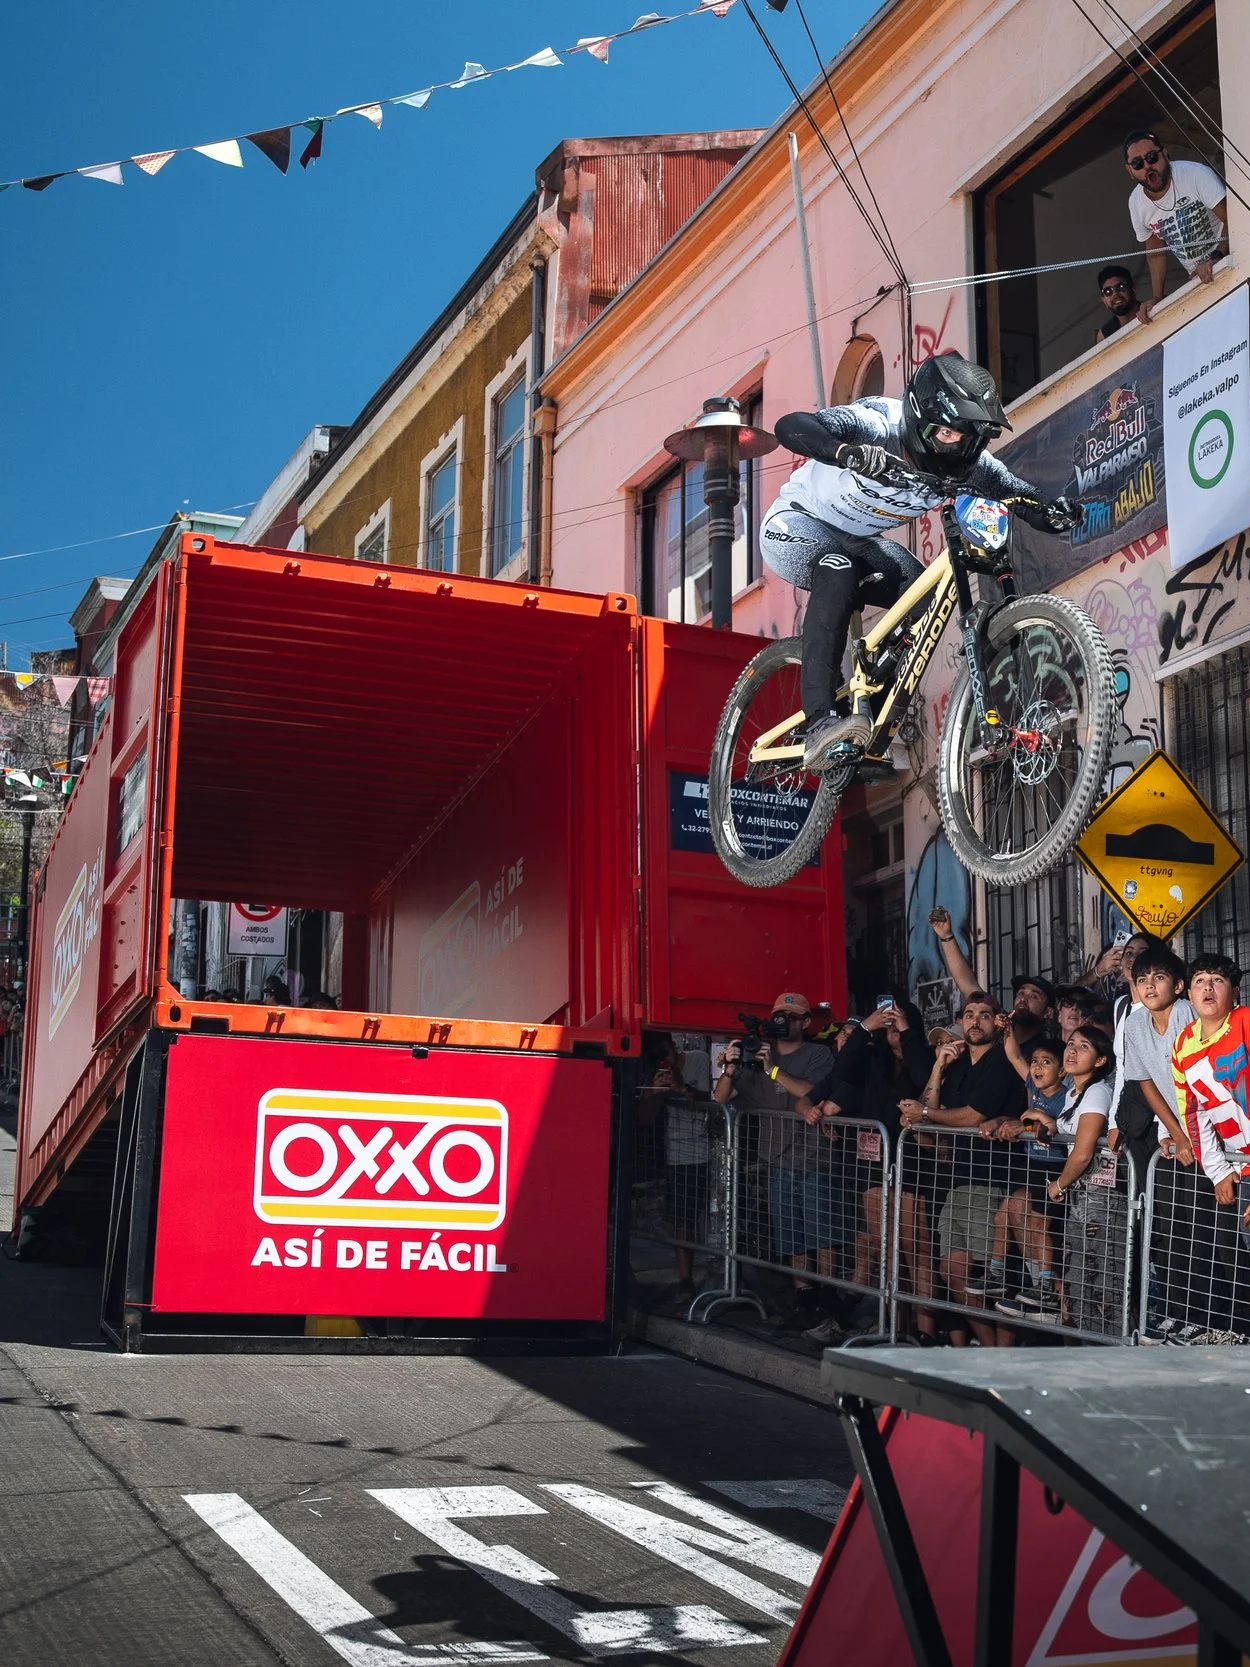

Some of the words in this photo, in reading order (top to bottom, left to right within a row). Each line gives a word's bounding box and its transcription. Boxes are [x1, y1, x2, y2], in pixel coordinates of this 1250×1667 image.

[1176, 200, 1204, 220] Minds
[1200, 365, 1209, 377] En
[1211, 340, 1247, 370] Instagram
[1178, 374, 1239, 419] @lakeka.valpo
[1086, 423, 1115, 465] Red
[1115, 405, 1146, 450] Bull
[1197, 440, 1223, 460] LAKEKA
[1074, 436, 1147, 496] VALPARAISO
[1114, 459, 1154, 527] ABAJO
[730, 788, 808, 808] OXCONTEMAR
[746, 816, 799, 831] ARRIENDO
[485, 865, 506, 918] ASÍ
[508, 857, 524, 896] DE
[269, 1121, 495, 1199] OXXO
[250, 1228, 324, 1268] ASÍ
[337, 1239, 388, 1269] DE
[401, 1232, 507, 1272] FÁCIL
